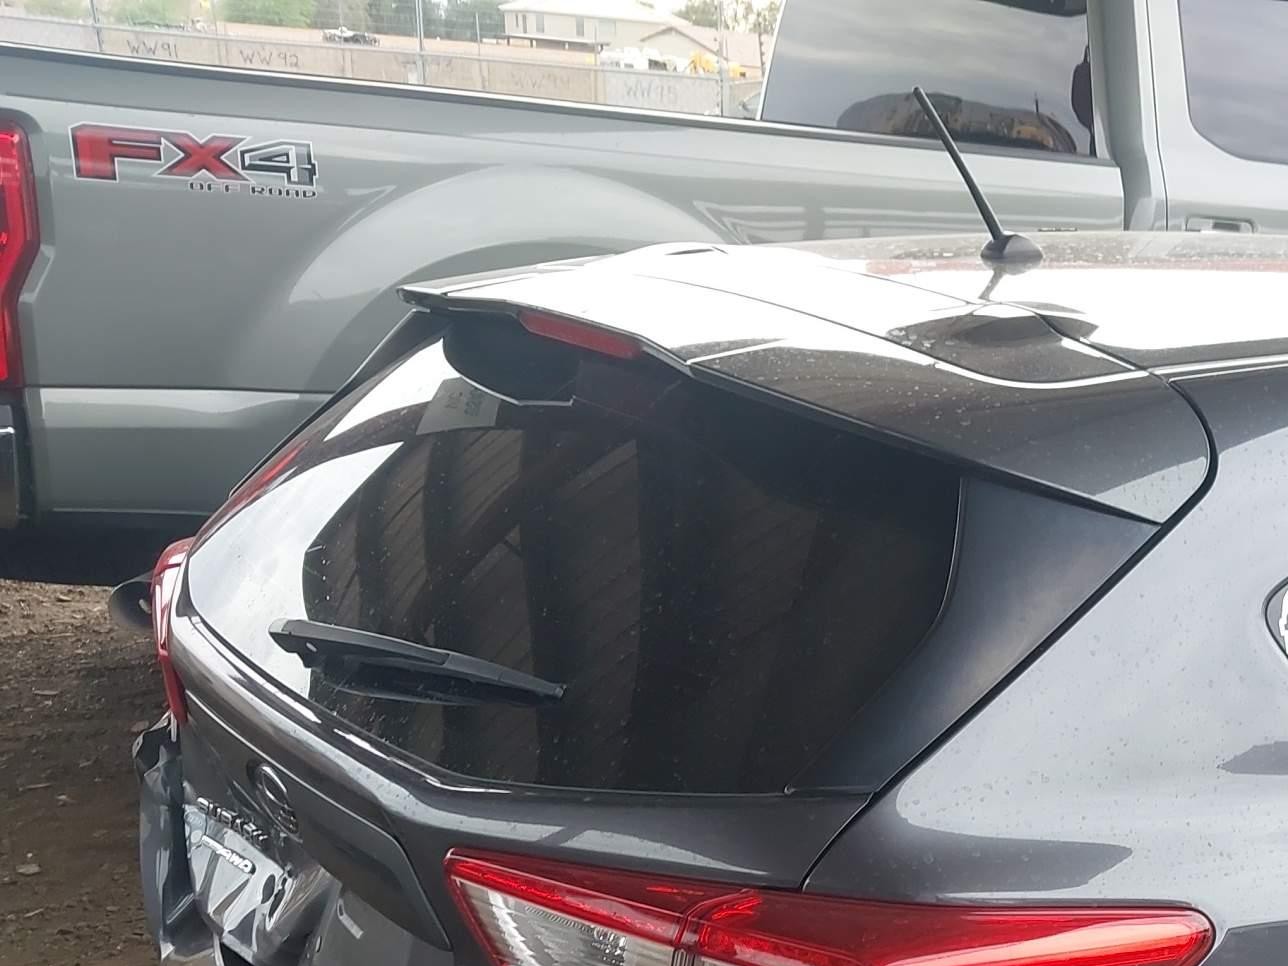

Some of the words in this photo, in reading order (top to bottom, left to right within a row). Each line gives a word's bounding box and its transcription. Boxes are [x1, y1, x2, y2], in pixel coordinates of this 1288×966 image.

[68, 120, 319, 188] FX4
[188, 180, 242, 194] OFF
[250, 184, 318, 199] ROAD
